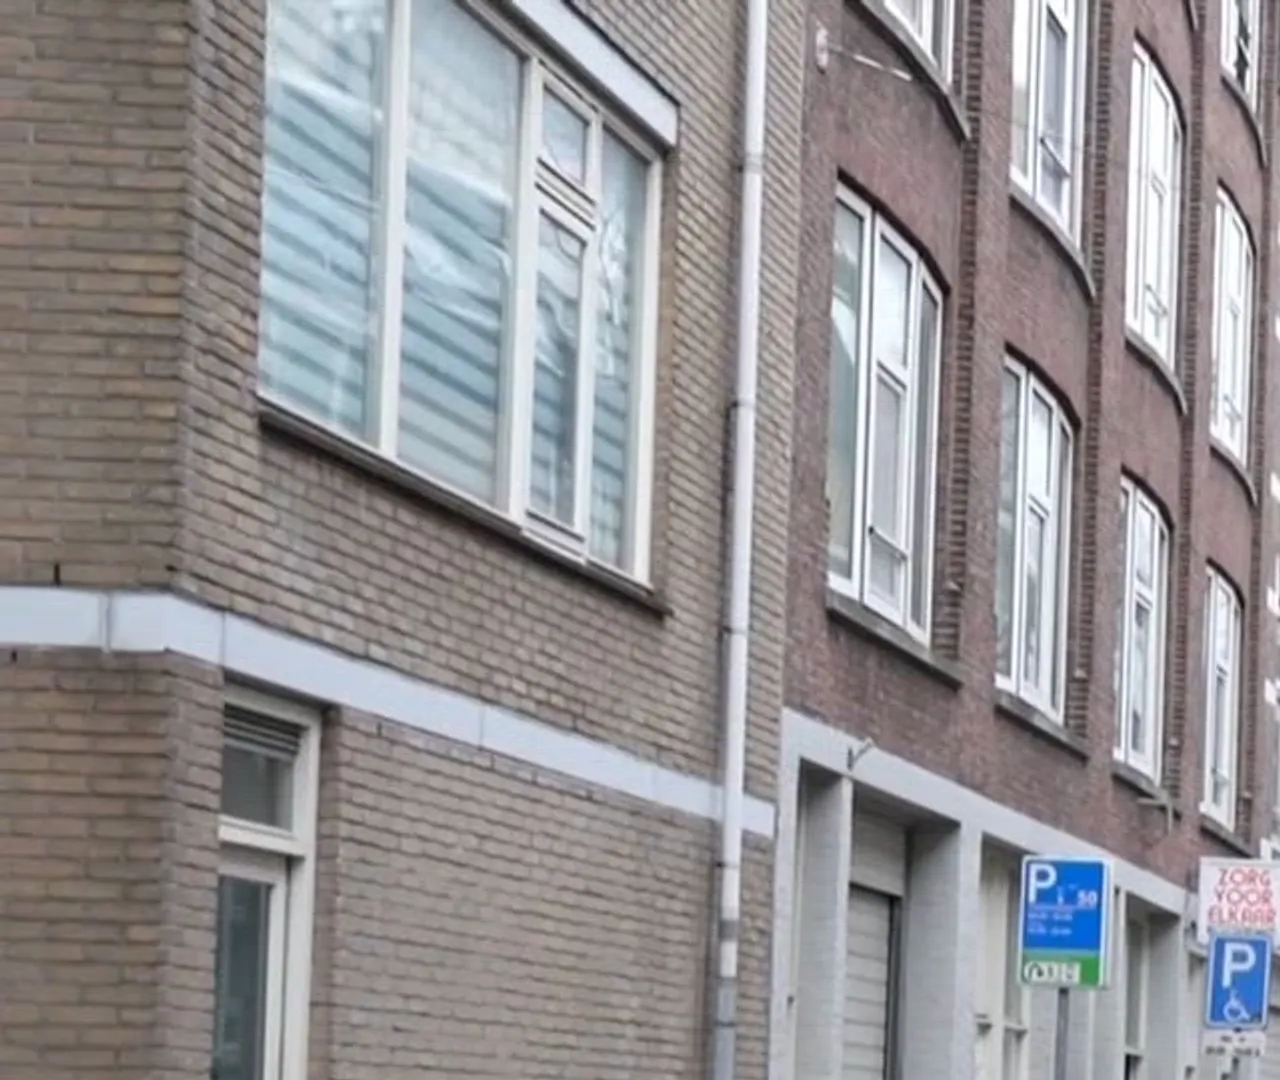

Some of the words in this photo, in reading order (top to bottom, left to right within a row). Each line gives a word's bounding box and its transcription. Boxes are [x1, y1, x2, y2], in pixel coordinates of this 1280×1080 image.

[1028, 863, 1057, 903] P
[1218, 867, 1271, 887] ZORG
[1208, 905, 1277, 923] ELKAAR
[1221, 942, 1257, 988] P
